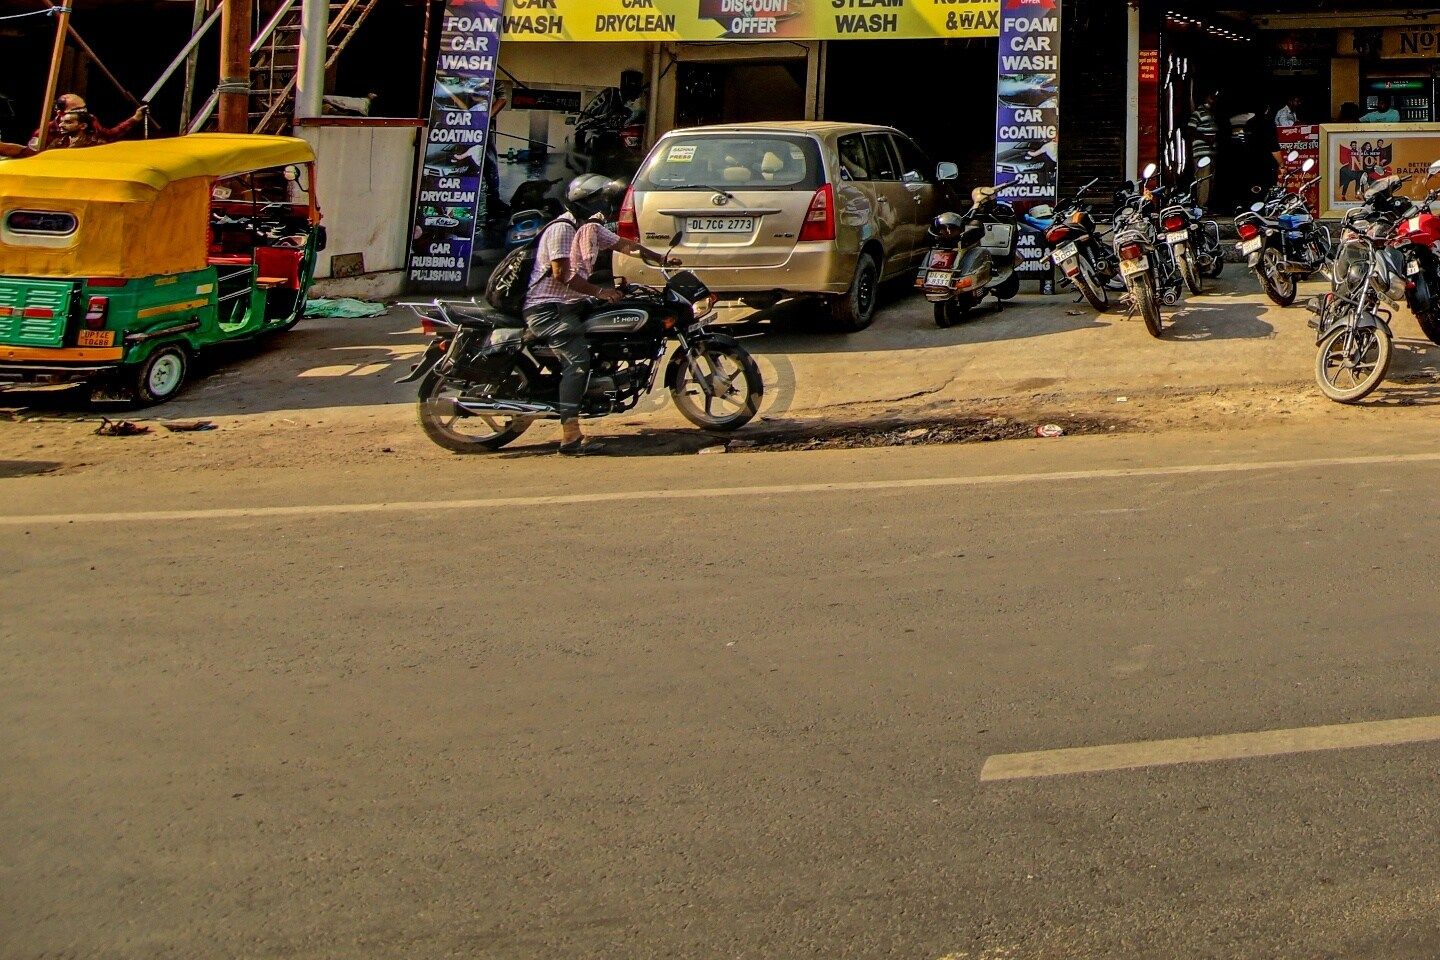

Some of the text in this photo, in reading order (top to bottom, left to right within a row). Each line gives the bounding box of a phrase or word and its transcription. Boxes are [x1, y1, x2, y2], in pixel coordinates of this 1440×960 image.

[446, 16, 498, 33] FOAM
[501, 15, 564, 35] WASH
[595, 14, 675, 33] DRYCLEAN
[731, 17, 778, 35] OFFER
[835, 14, 897, 34] WASH
[1003, 17, 1058, 33] FOAM
[451, 36, 488, 51] CAR
[1010, 36, 1051, 52] CAR
[441, 55, 493, 71] WASH
[1001, 55, 1057, 71] WASH
[446, 112, 472, 126] CAR
[1014, 109, 1043, 122] CAR
[430, 129, 483, 143] COATING
[1000, 125, 1057, 140] COATING
[438, 178, 461, 189] CAR
[420, 191, 475, 203] DRYCLEAN
[727, 218, 752, 230] 2773
[429, 243, 451, 254] CAR
[412, 256, 465, 268] RUBBING &
